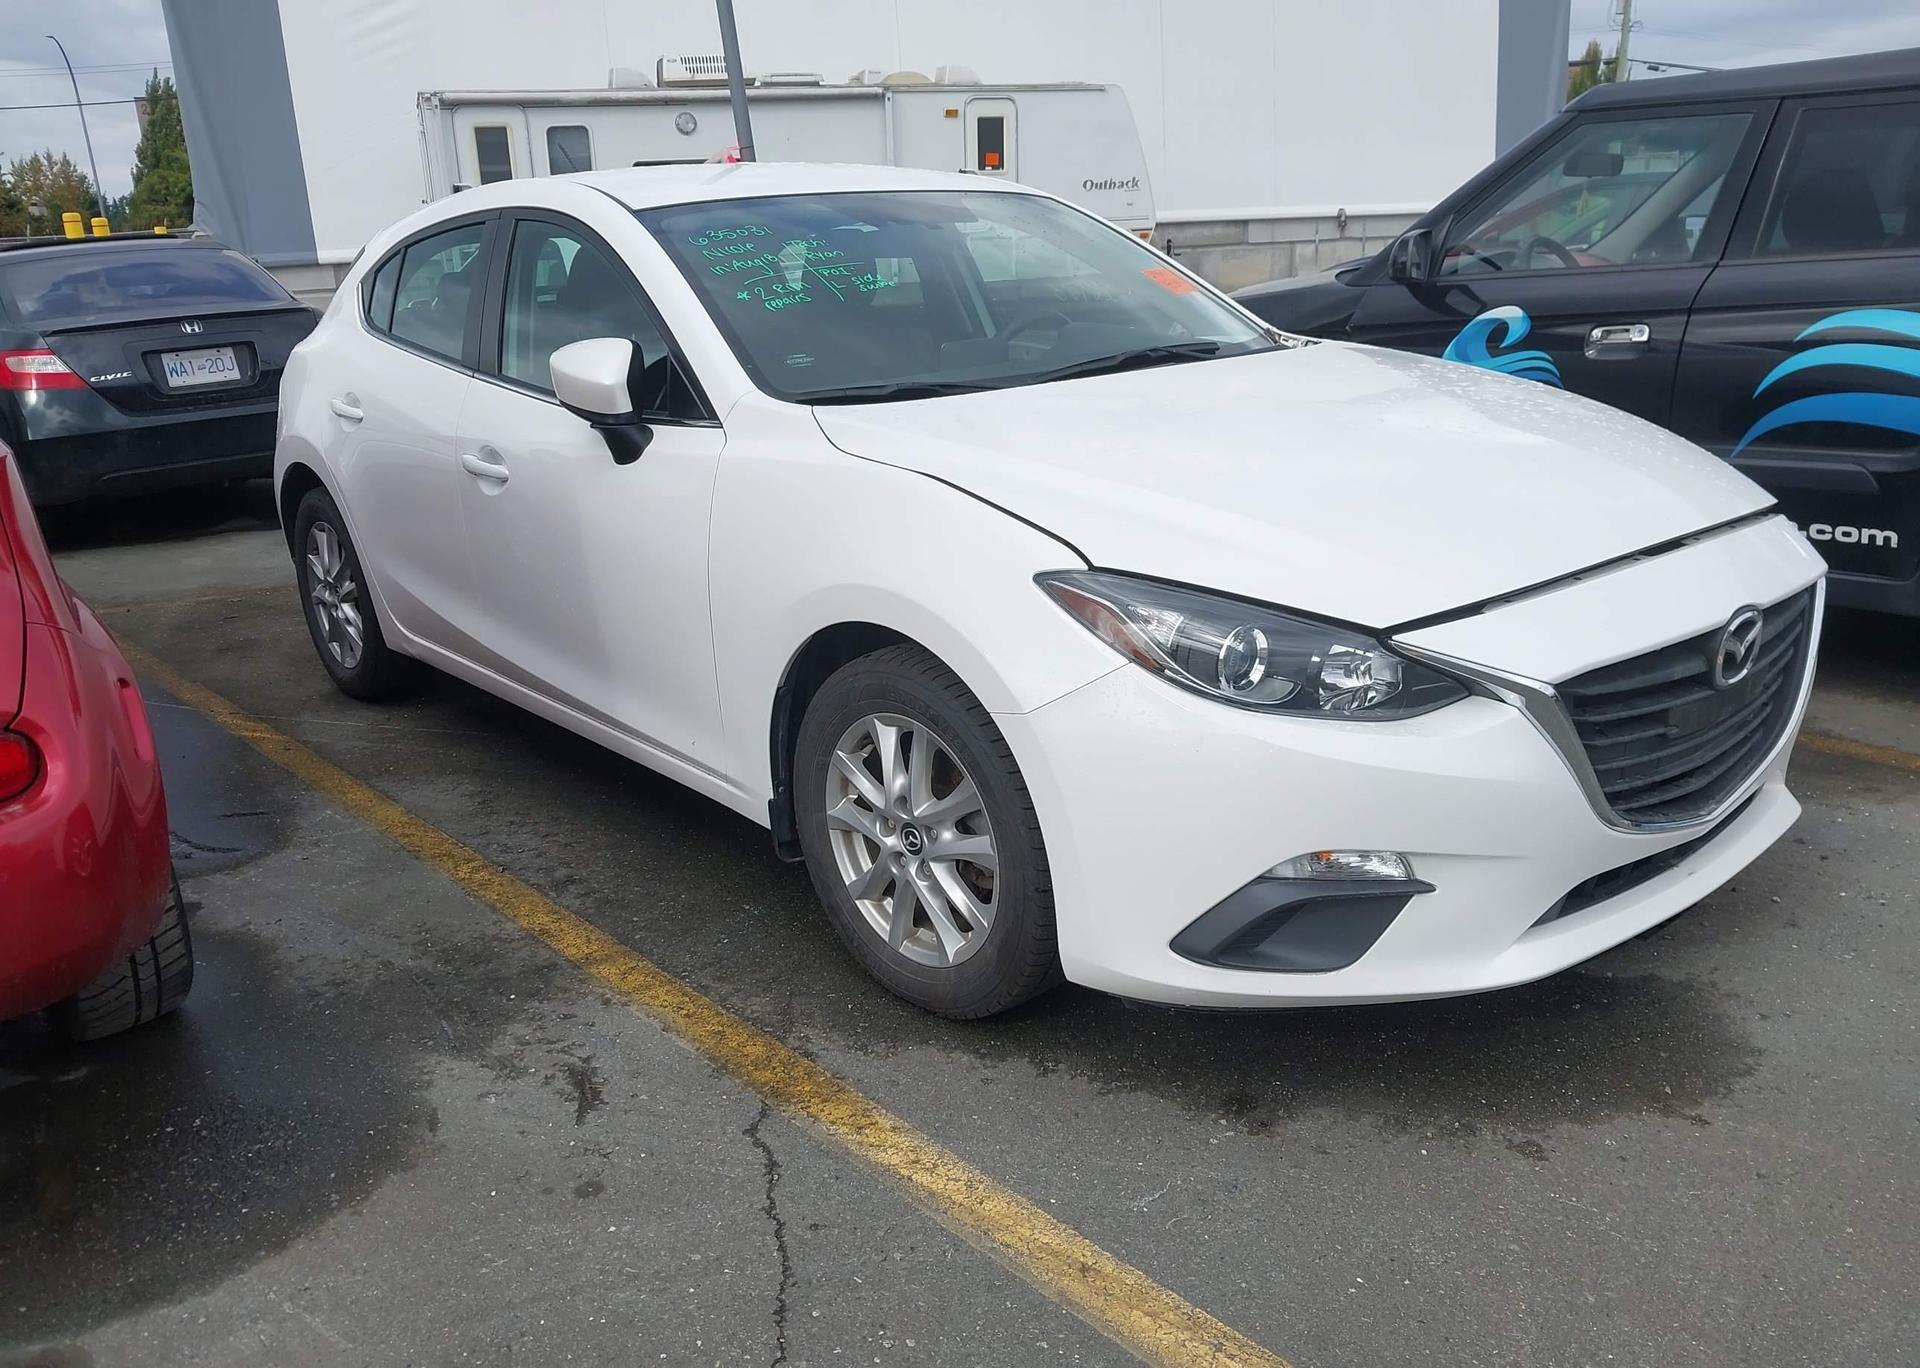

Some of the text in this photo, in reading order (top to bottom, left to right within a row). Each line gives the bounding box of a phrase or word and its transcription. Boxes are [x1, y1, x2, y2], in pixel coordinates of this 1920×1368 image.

[1082, 176, 1140, 192] Outback
[688, 225, 774, 246] 635031
[754, 286, 775, 300] 2
[764, 293, 812, 312] repairs
[90, 370, 132, 382] CIVIC
